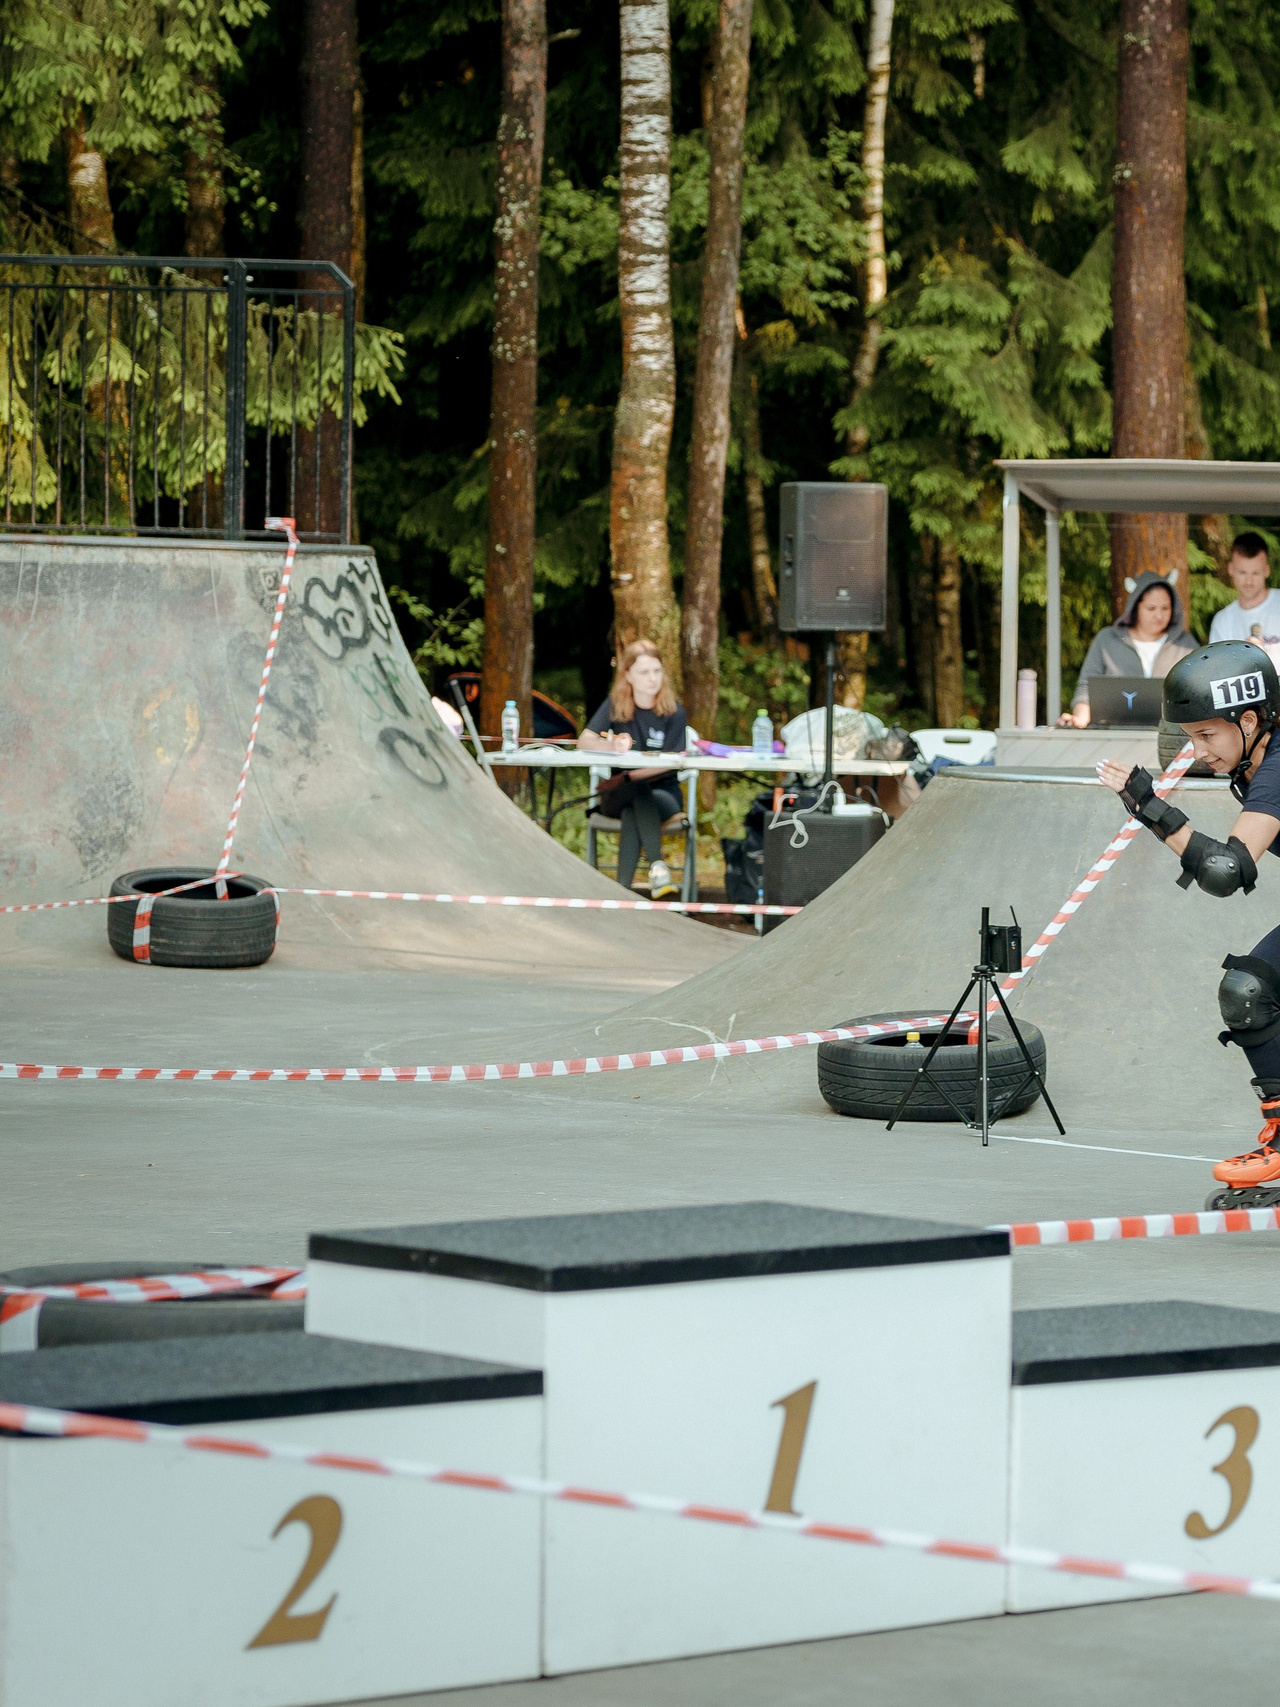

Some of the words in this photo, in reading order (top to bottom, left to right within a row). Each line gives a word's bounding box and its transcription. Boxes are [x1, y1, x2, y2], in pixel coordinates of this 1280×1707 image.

[1217, 675, 1261, 705] 119
[765, 1380, 817, 1516] 1
[1184, 1405, 1262, 1541] 3
[244, 1493, 347, 1652] 2
